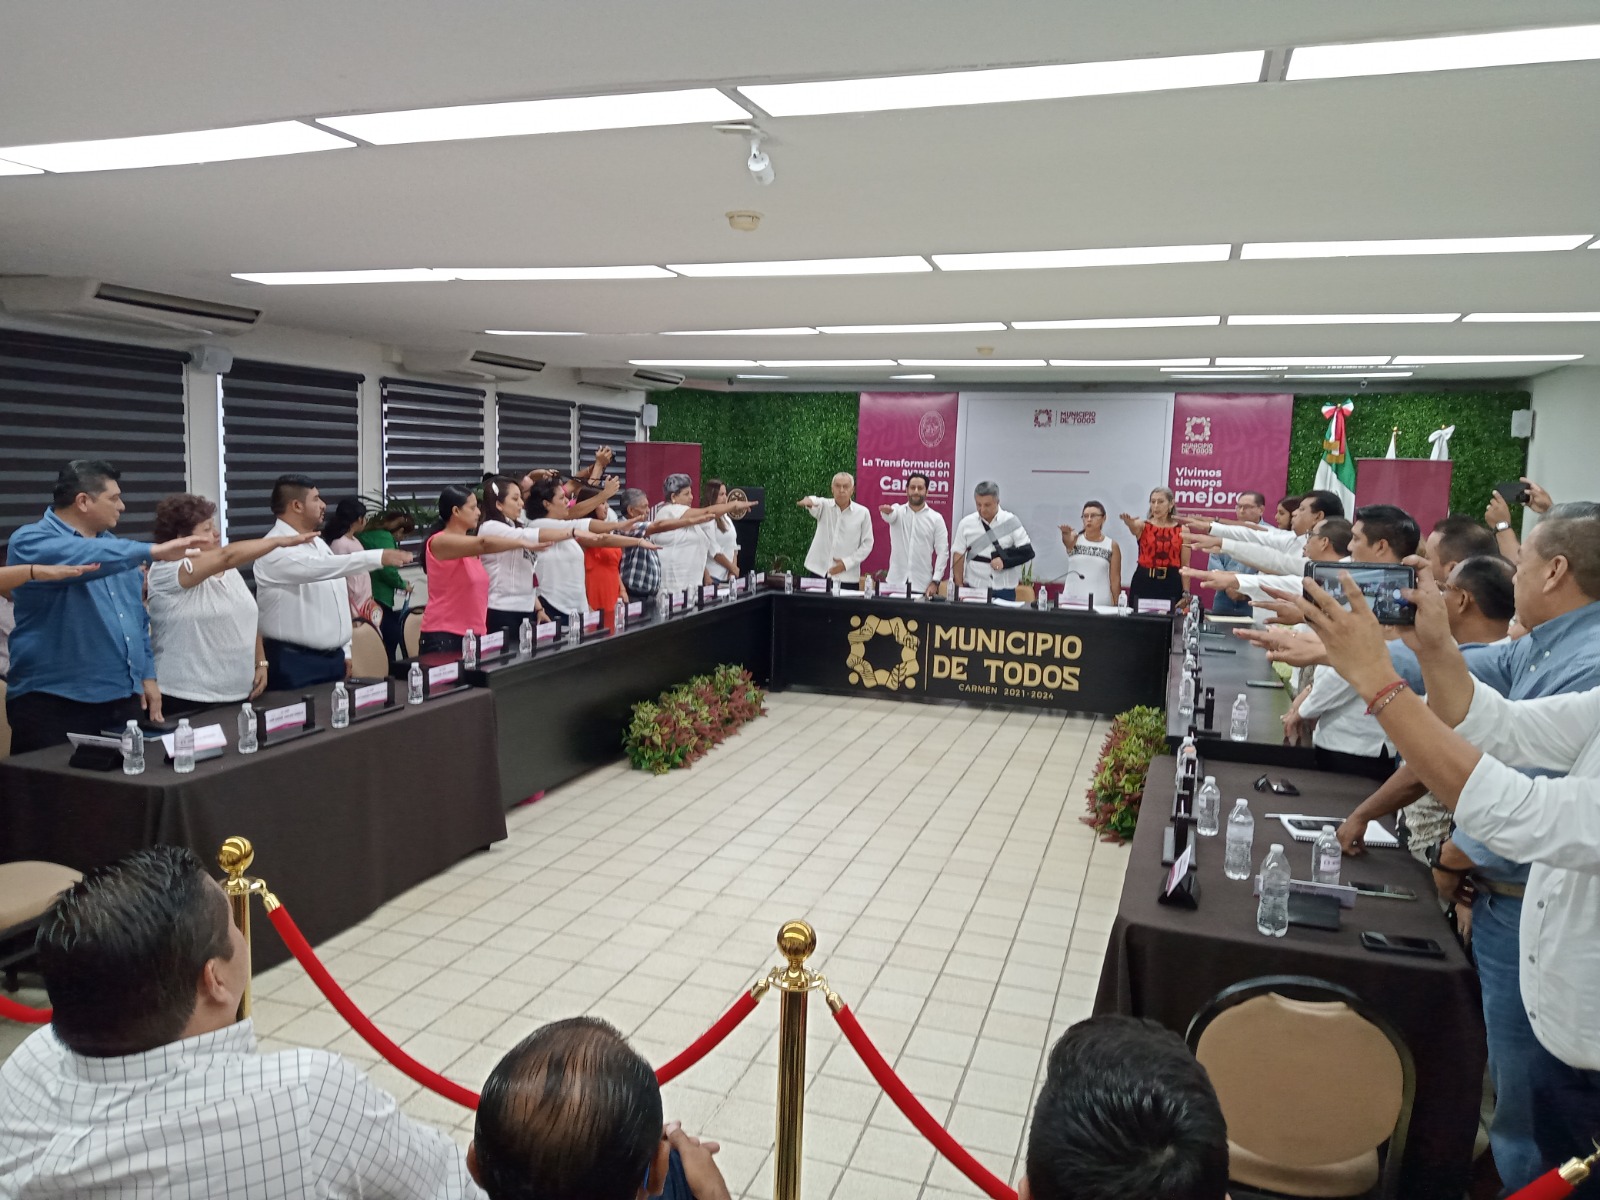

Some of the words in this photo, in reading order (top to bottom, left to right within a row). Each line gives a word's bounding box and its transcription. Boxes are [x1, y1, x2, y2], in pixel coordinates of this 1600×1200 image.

[862, 458, 873, 467] La
[875, 458, 950, 469] Transformación
[937, 470, 950, 478] en
[1175, 467, 1222, 478] Vivimos
[880, 476, 949, 492] Caren
[1175, 477, 1222, 489] tiempos
[934, 624, 1083, 660] MUNICIPIO
[932, 654, 969, 681] DE
[983, 658, 1081, 692] TODOS
[958, 683, 998, 695] CARMEN
